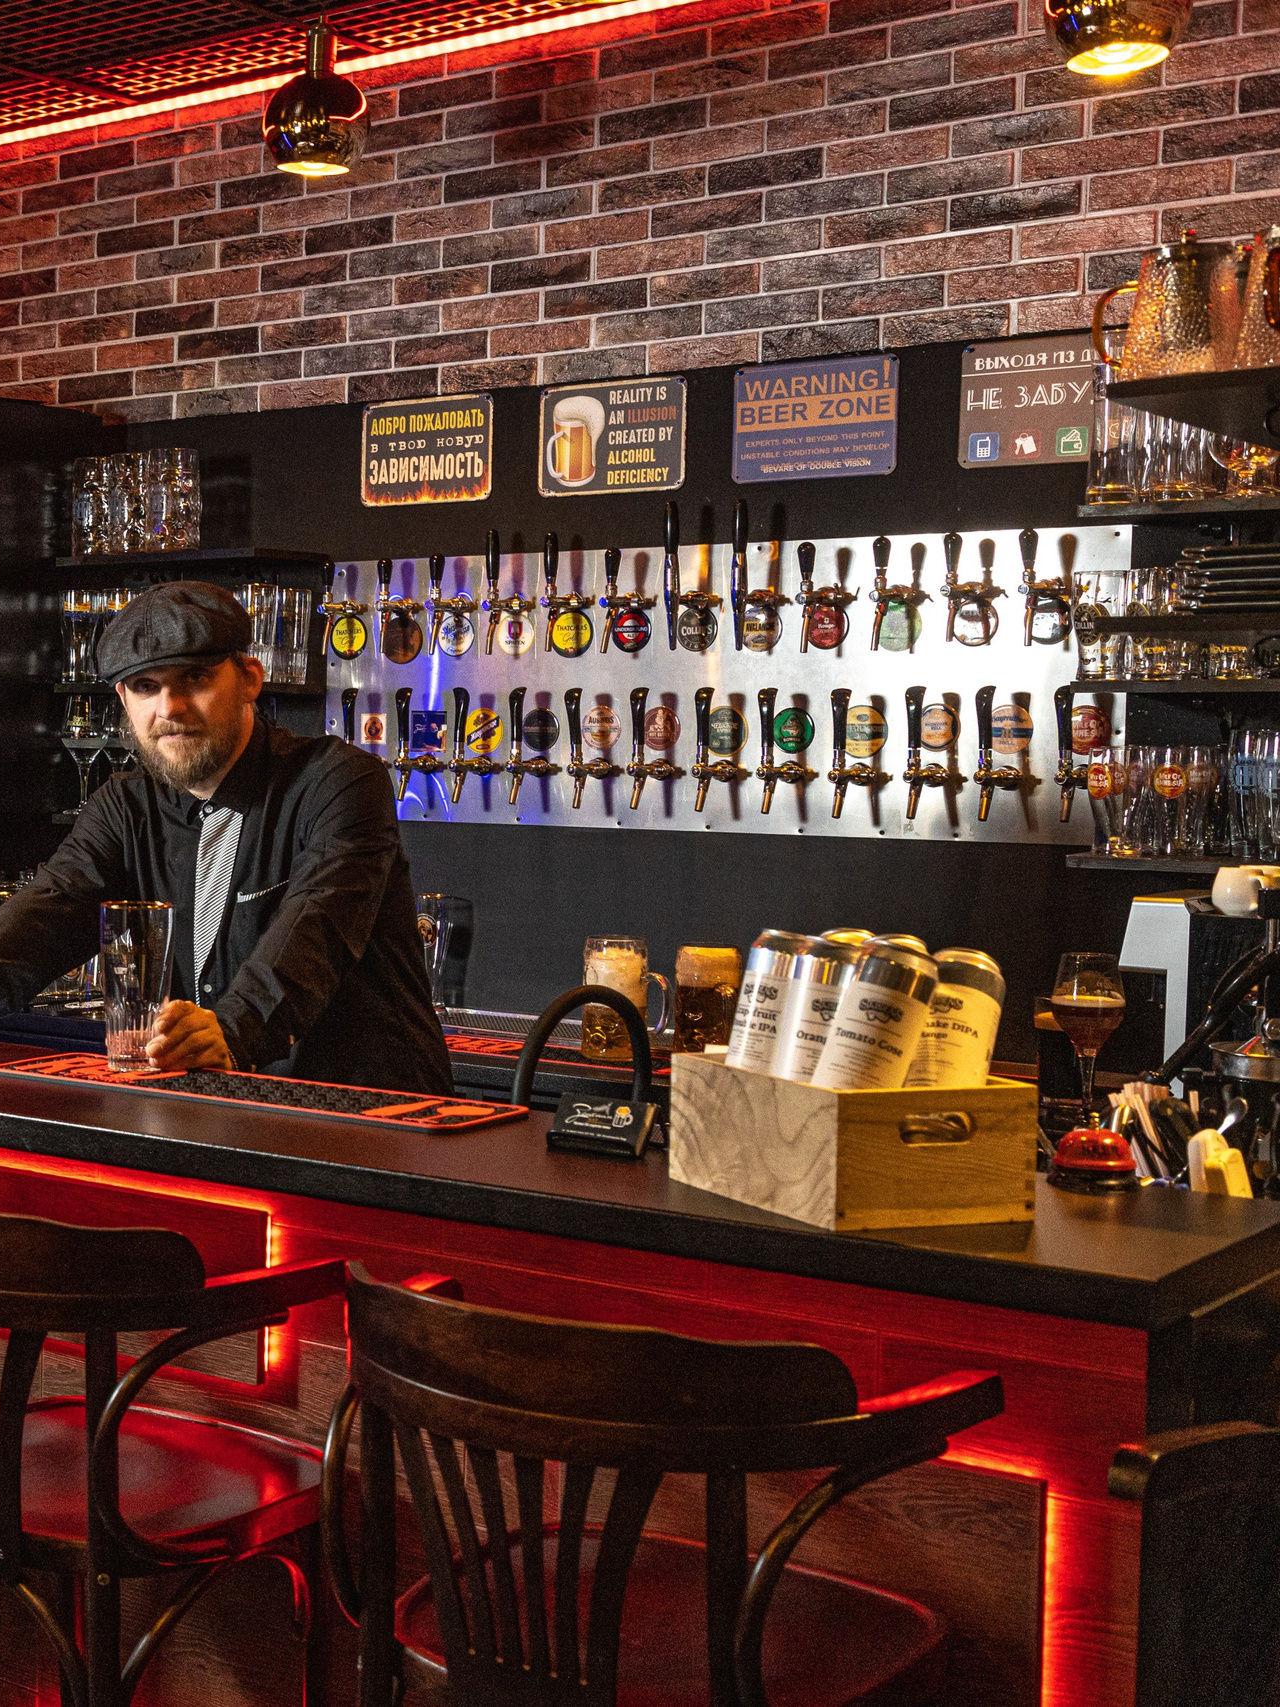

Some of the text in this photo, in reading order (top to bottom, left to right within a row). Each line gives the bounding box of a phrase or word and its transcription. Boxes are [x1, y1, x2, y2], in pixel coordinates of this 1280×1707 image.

[974, 352, 1049, 371] ВЫХОДЯ
[745, 359, 891, 401] WARNING!
[609, 386, 668, 405] REALITY IS
[967, 380, 1094, 411] НЕ ЗАБУ
[608, 406, 677, 426] AN ILLUSION
[740, 394, 891, 427] BEER ZONE
[370, 408, 485, 437] ДОБРО ПОЖАЛОВАТЬ
[608, 426, 674, 445] CREATED BY
[745, 430, 886, 449] EXPERTS ONLY BEYOND THIS POINT
[607, 448, 656, 465] ALCOHOL
[740, 443, 890, 461] UNSTABLE CONDITIONS MAY DEVELOP
[368, 452, 484, 486] ЗАВИСИМОСТЬ
[796, 463, 806, 472] OF
[810, 461, 842, 470] DOUBLE
[844, 459, 871, 469] VISION
[607, 467, 670, 486] DEFICIENCY
[681, 624, 714, 637] COLLIS
[758, 1022, 778, 1034] IPA
[835, 1026, 877, 1046] Tomato
[951, 1022, 979, 1039] DIPA
